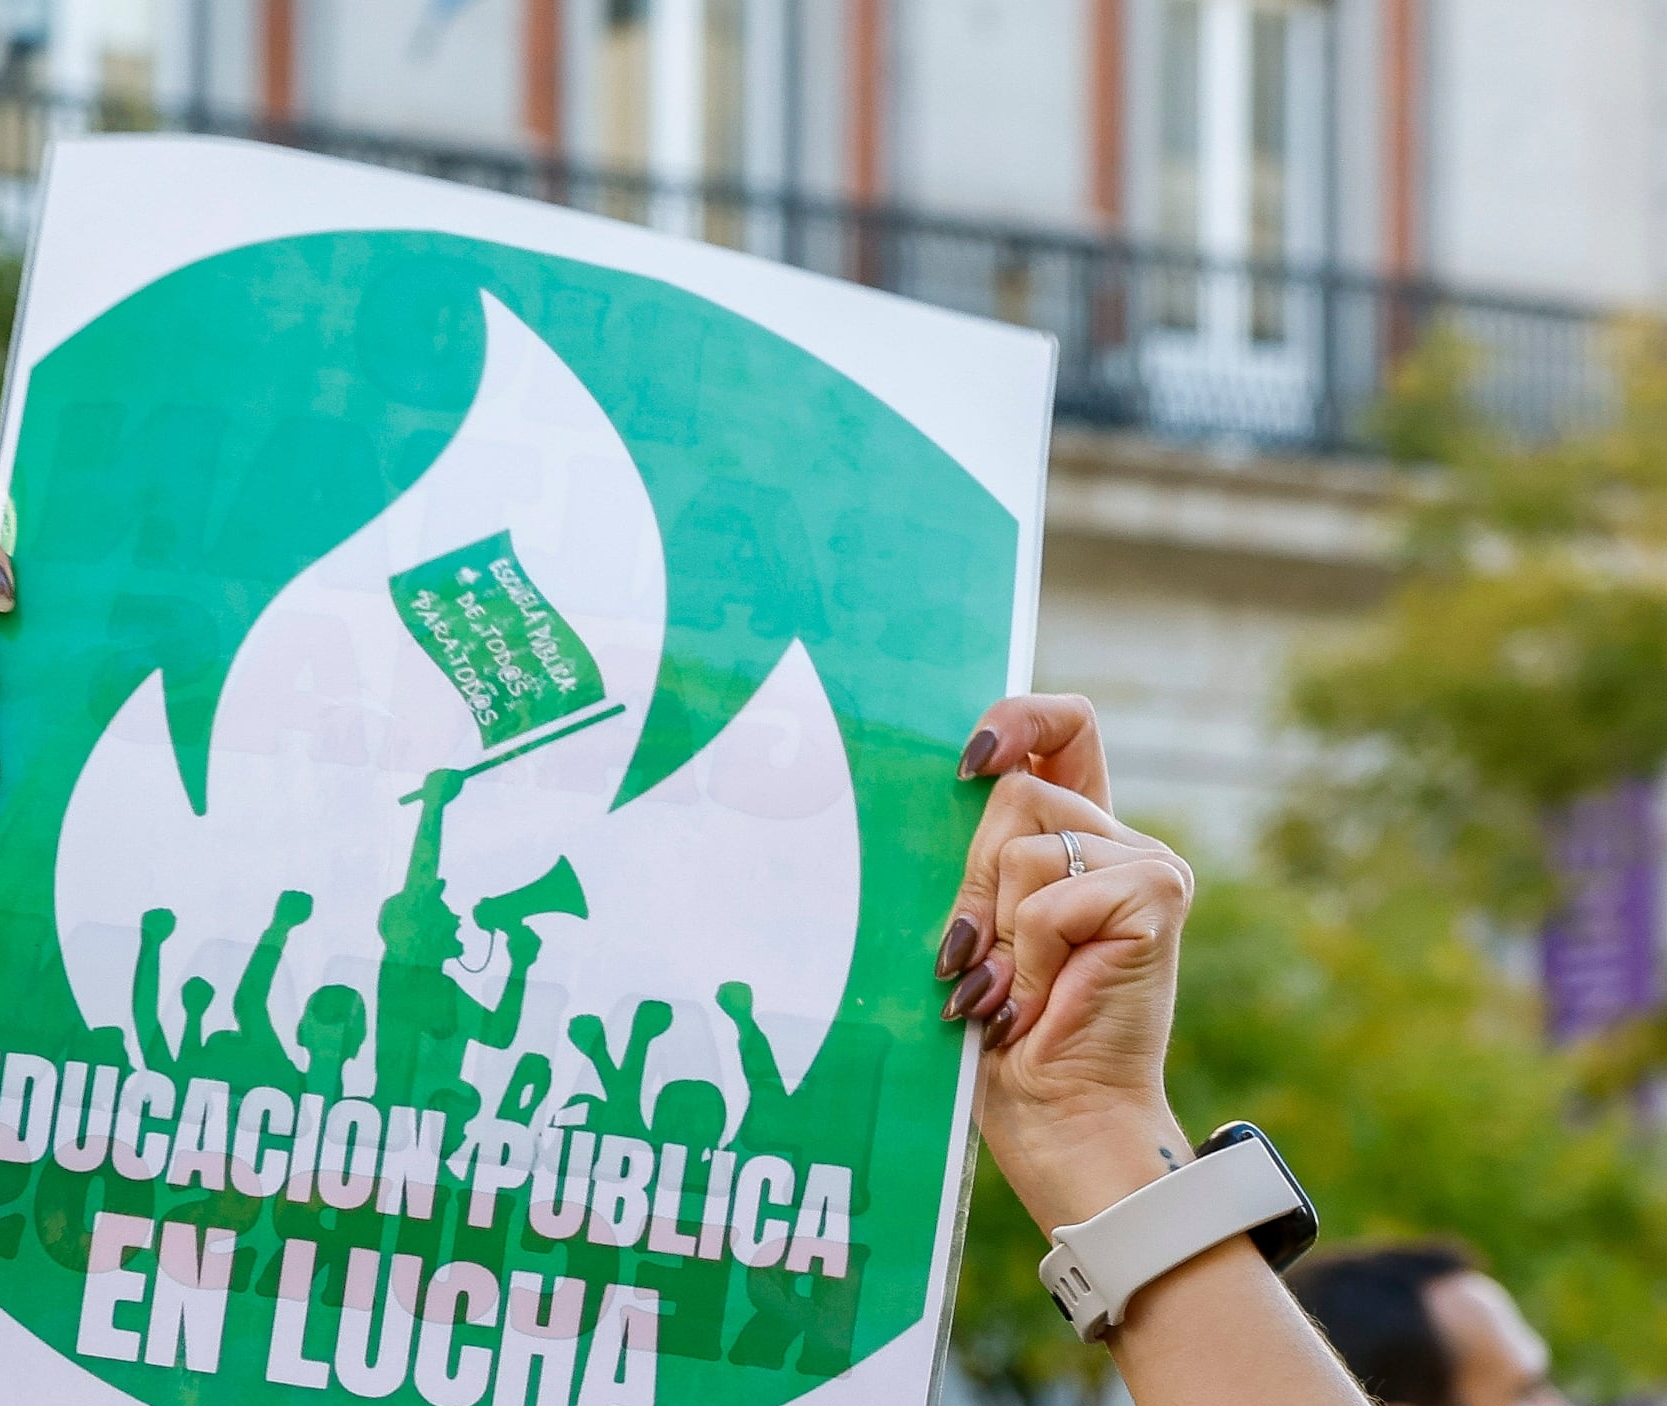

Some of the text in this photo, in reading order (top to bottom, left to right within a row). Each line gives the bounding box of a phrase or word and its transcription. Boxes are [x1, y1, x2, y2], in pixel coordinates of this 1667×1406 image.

[410, 588, 462, 656] PARA
[455, 591, 487, 622] DE
[487, 558, 548, 628] ESCUELA
[465, 1103, 853, 1280] PÚBLICA
[75, 1210, 237, 1374] EN
